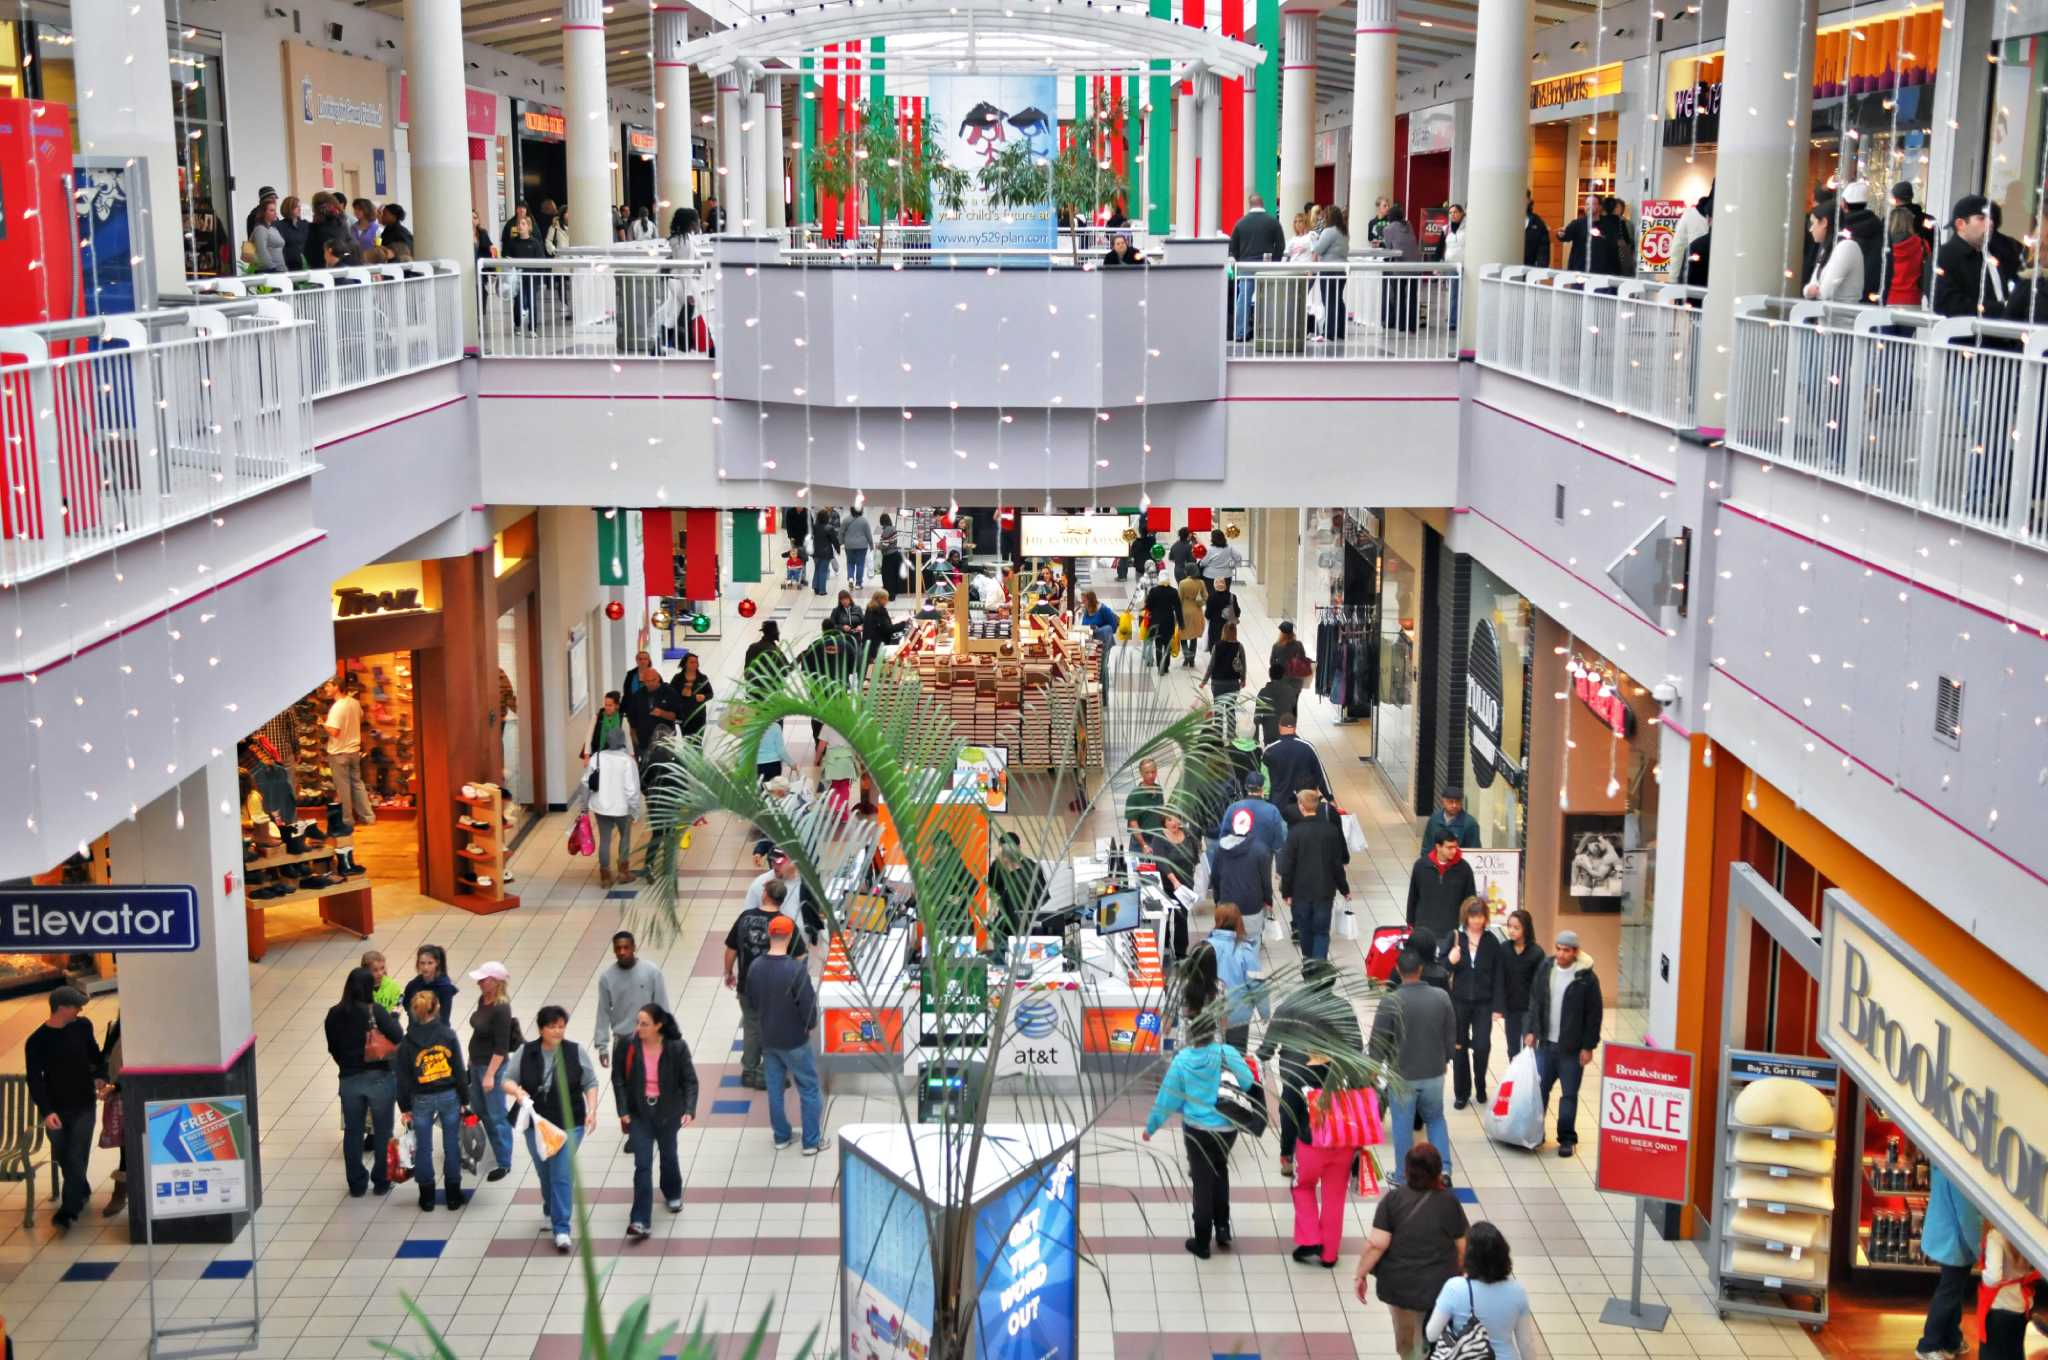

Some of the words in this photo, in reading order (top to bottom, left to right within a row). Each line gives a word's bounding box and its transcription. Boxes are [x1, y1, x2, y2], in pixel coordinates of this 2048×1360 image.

[1675, 86, 1701, 118] wet
[12, 904, 175, 936] Elevator
[1014, 1047, 1059, 1064] at&t
[1747, 1064, 1761, 1074] Buy
[1773, 1067, 1788, 1076] Get
[1615, 1063, 1678, 1082] Brookstone
[179, 1110, 217, 1132] FREE
[1609, 1091, 1682, 1134] SALE
[1610, 1135, 1629, 1145] THIS
[1631, 1138, 1653, 1149] WEEK
[1009, 1208, 1040, 1247] GET
[1010, 1237, 1041, 1277] THE
[1000, 1263, 1048, 1312] WORD
[1008, 1296, 1040, 1336] OUT
